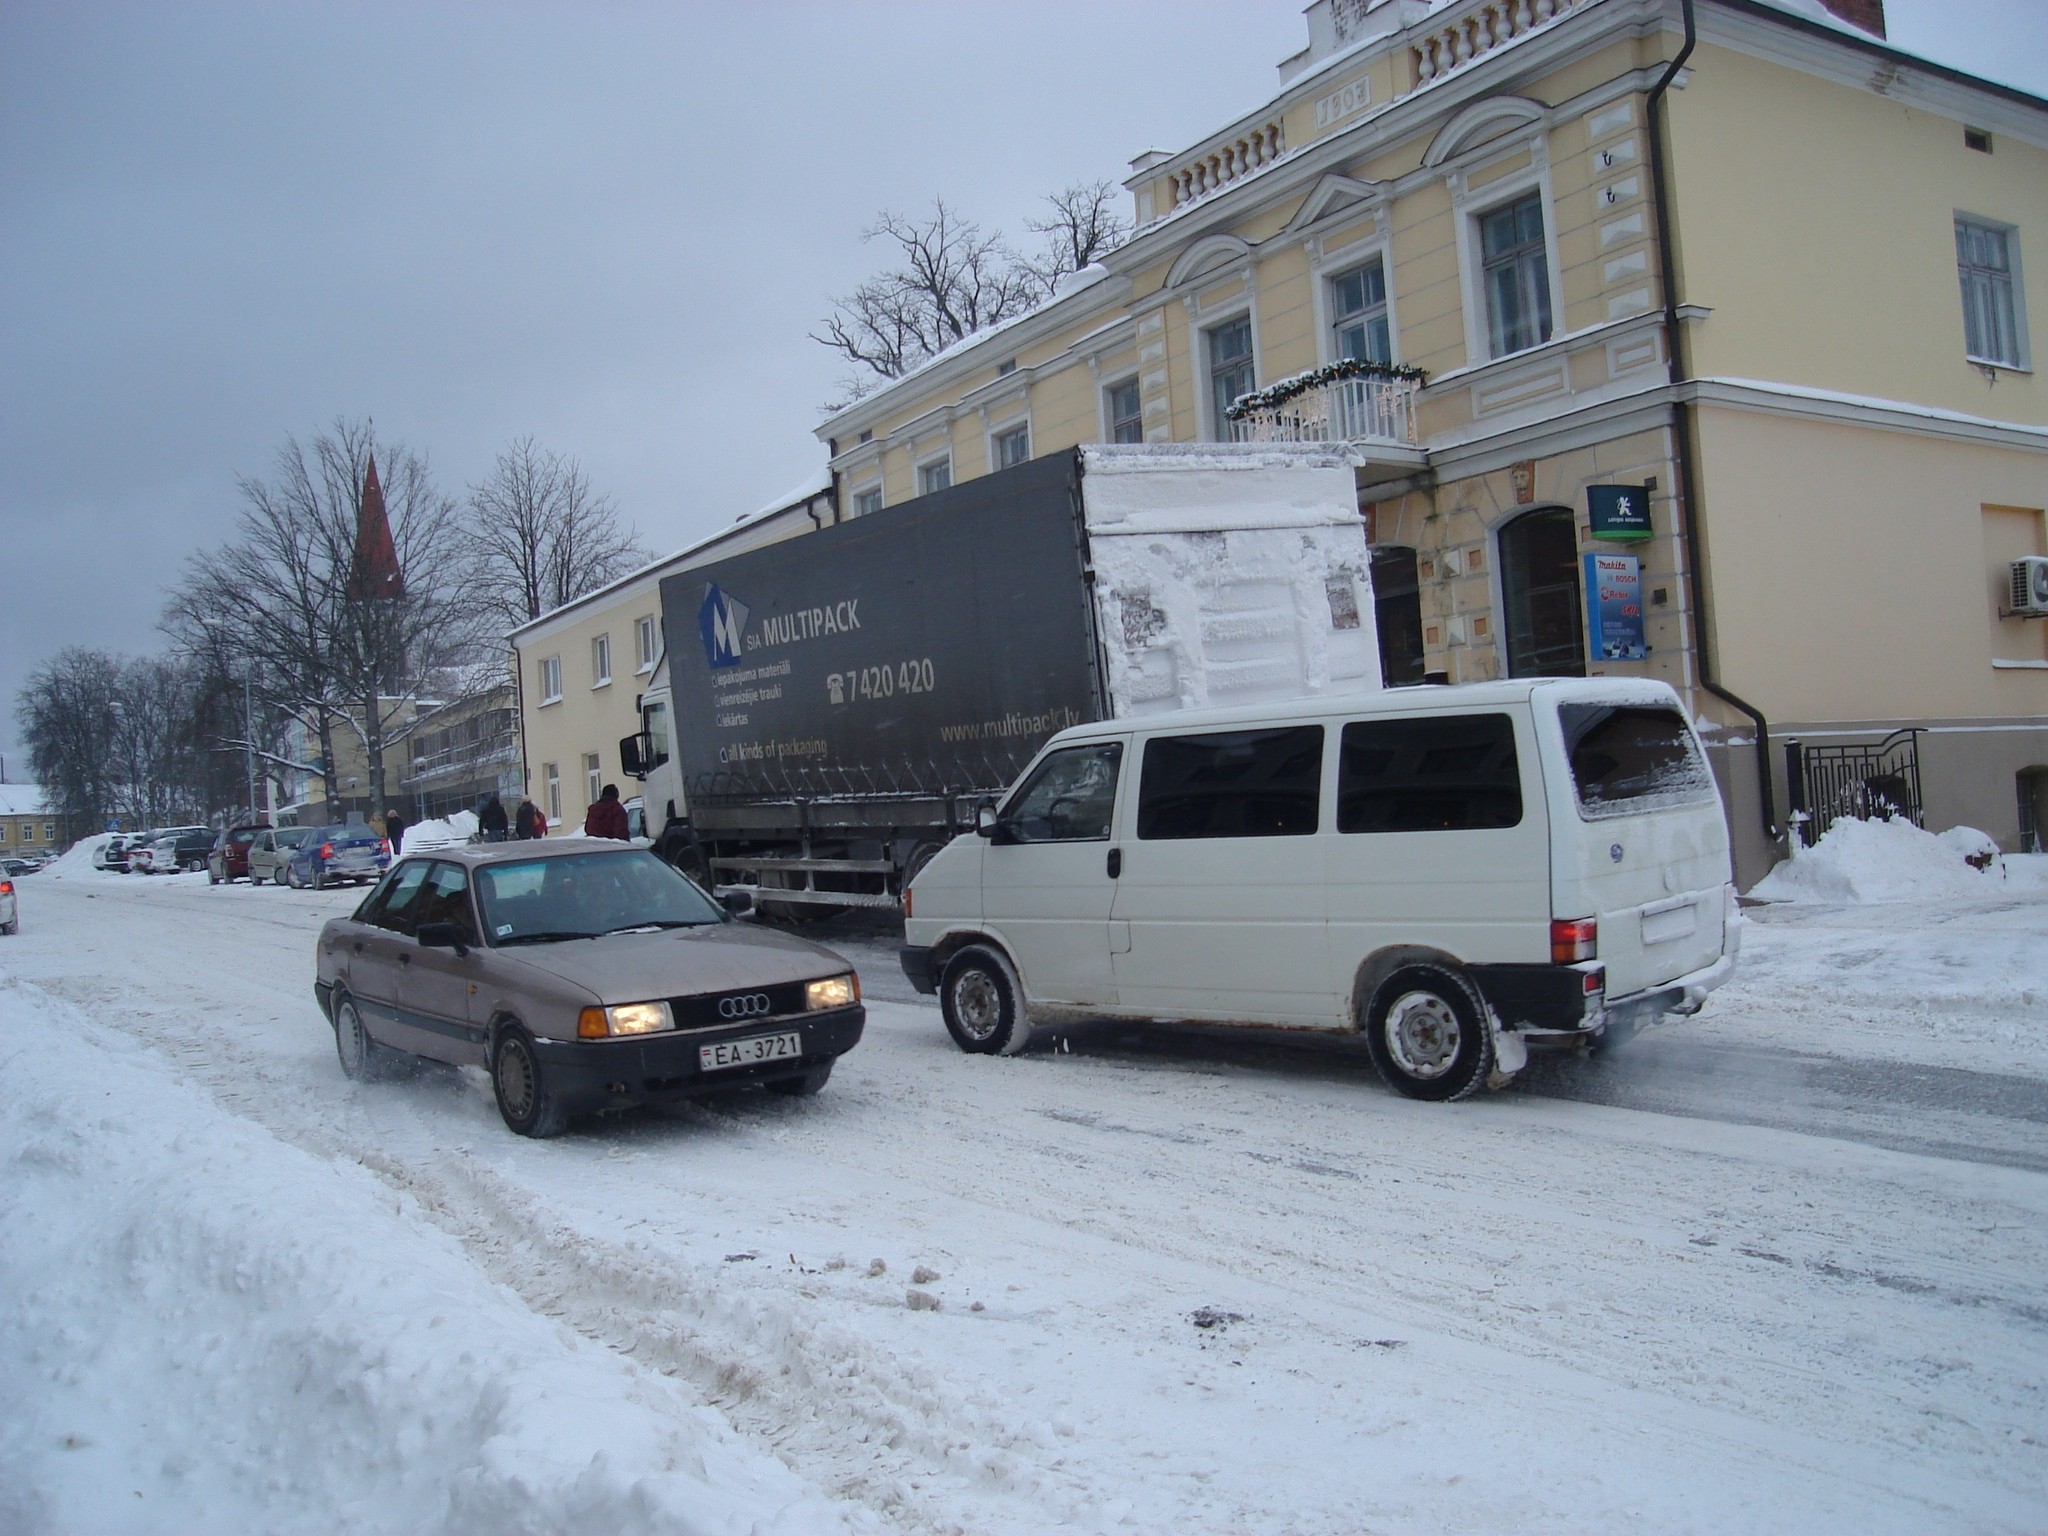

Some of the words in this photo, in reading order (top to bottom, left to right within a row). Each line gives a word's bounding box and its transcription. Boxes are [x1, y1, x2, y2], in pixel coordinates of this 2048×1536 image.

[1615, 575, 1637, 583] BOSCH
[747, 635, 762, 651] SIA
[763, 599, 861, 647] MULTIPACK
[717, 669, 757, 688] iepakojuma
[898, 658, 935, 694] 420
[760, 683, 782, 700] trauki
[940, 706, 1080, 743] www.multipack.lv
[728, 743, 738, 761] all
[740, 741, 763, 760] kinds
[765, 739, 776, 758] of
[778, 737, 828, 762] packaging
[715, 1036, 797, 1066] EA-3721
